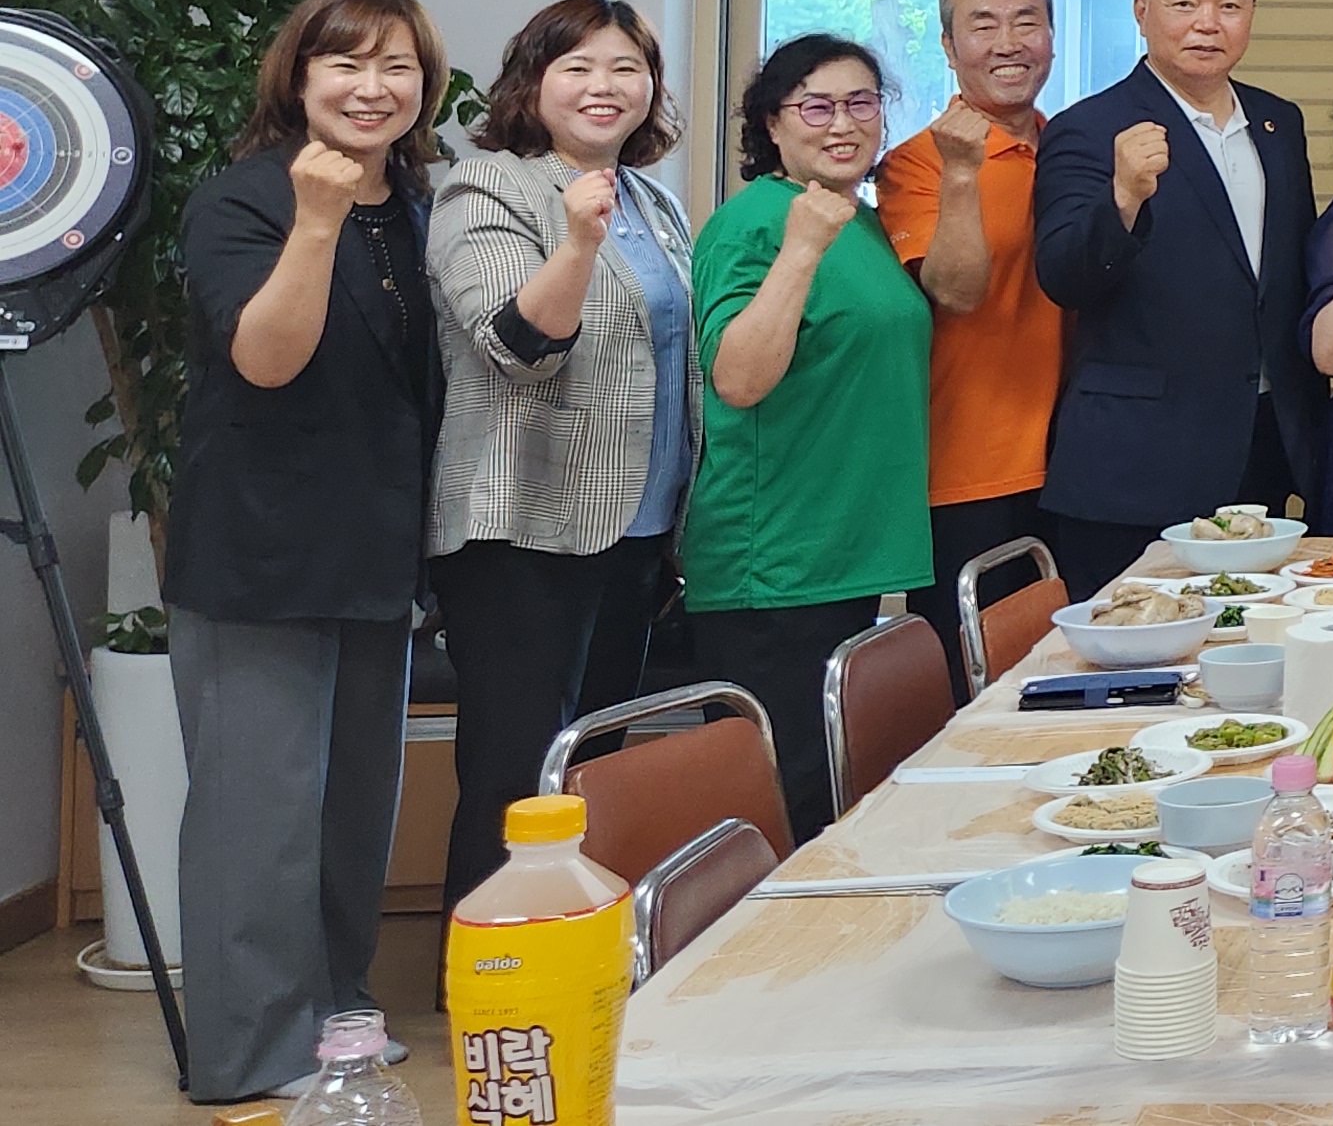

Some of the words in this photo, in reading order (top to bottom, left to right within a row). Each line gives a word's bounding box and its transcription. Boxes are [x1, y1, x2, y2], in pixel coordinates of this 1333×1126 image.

[474, 954, 523, 975] paldo
[463, 1025, 555, 1081] 비락
[467, 1075, 558, 1126] 식혜
